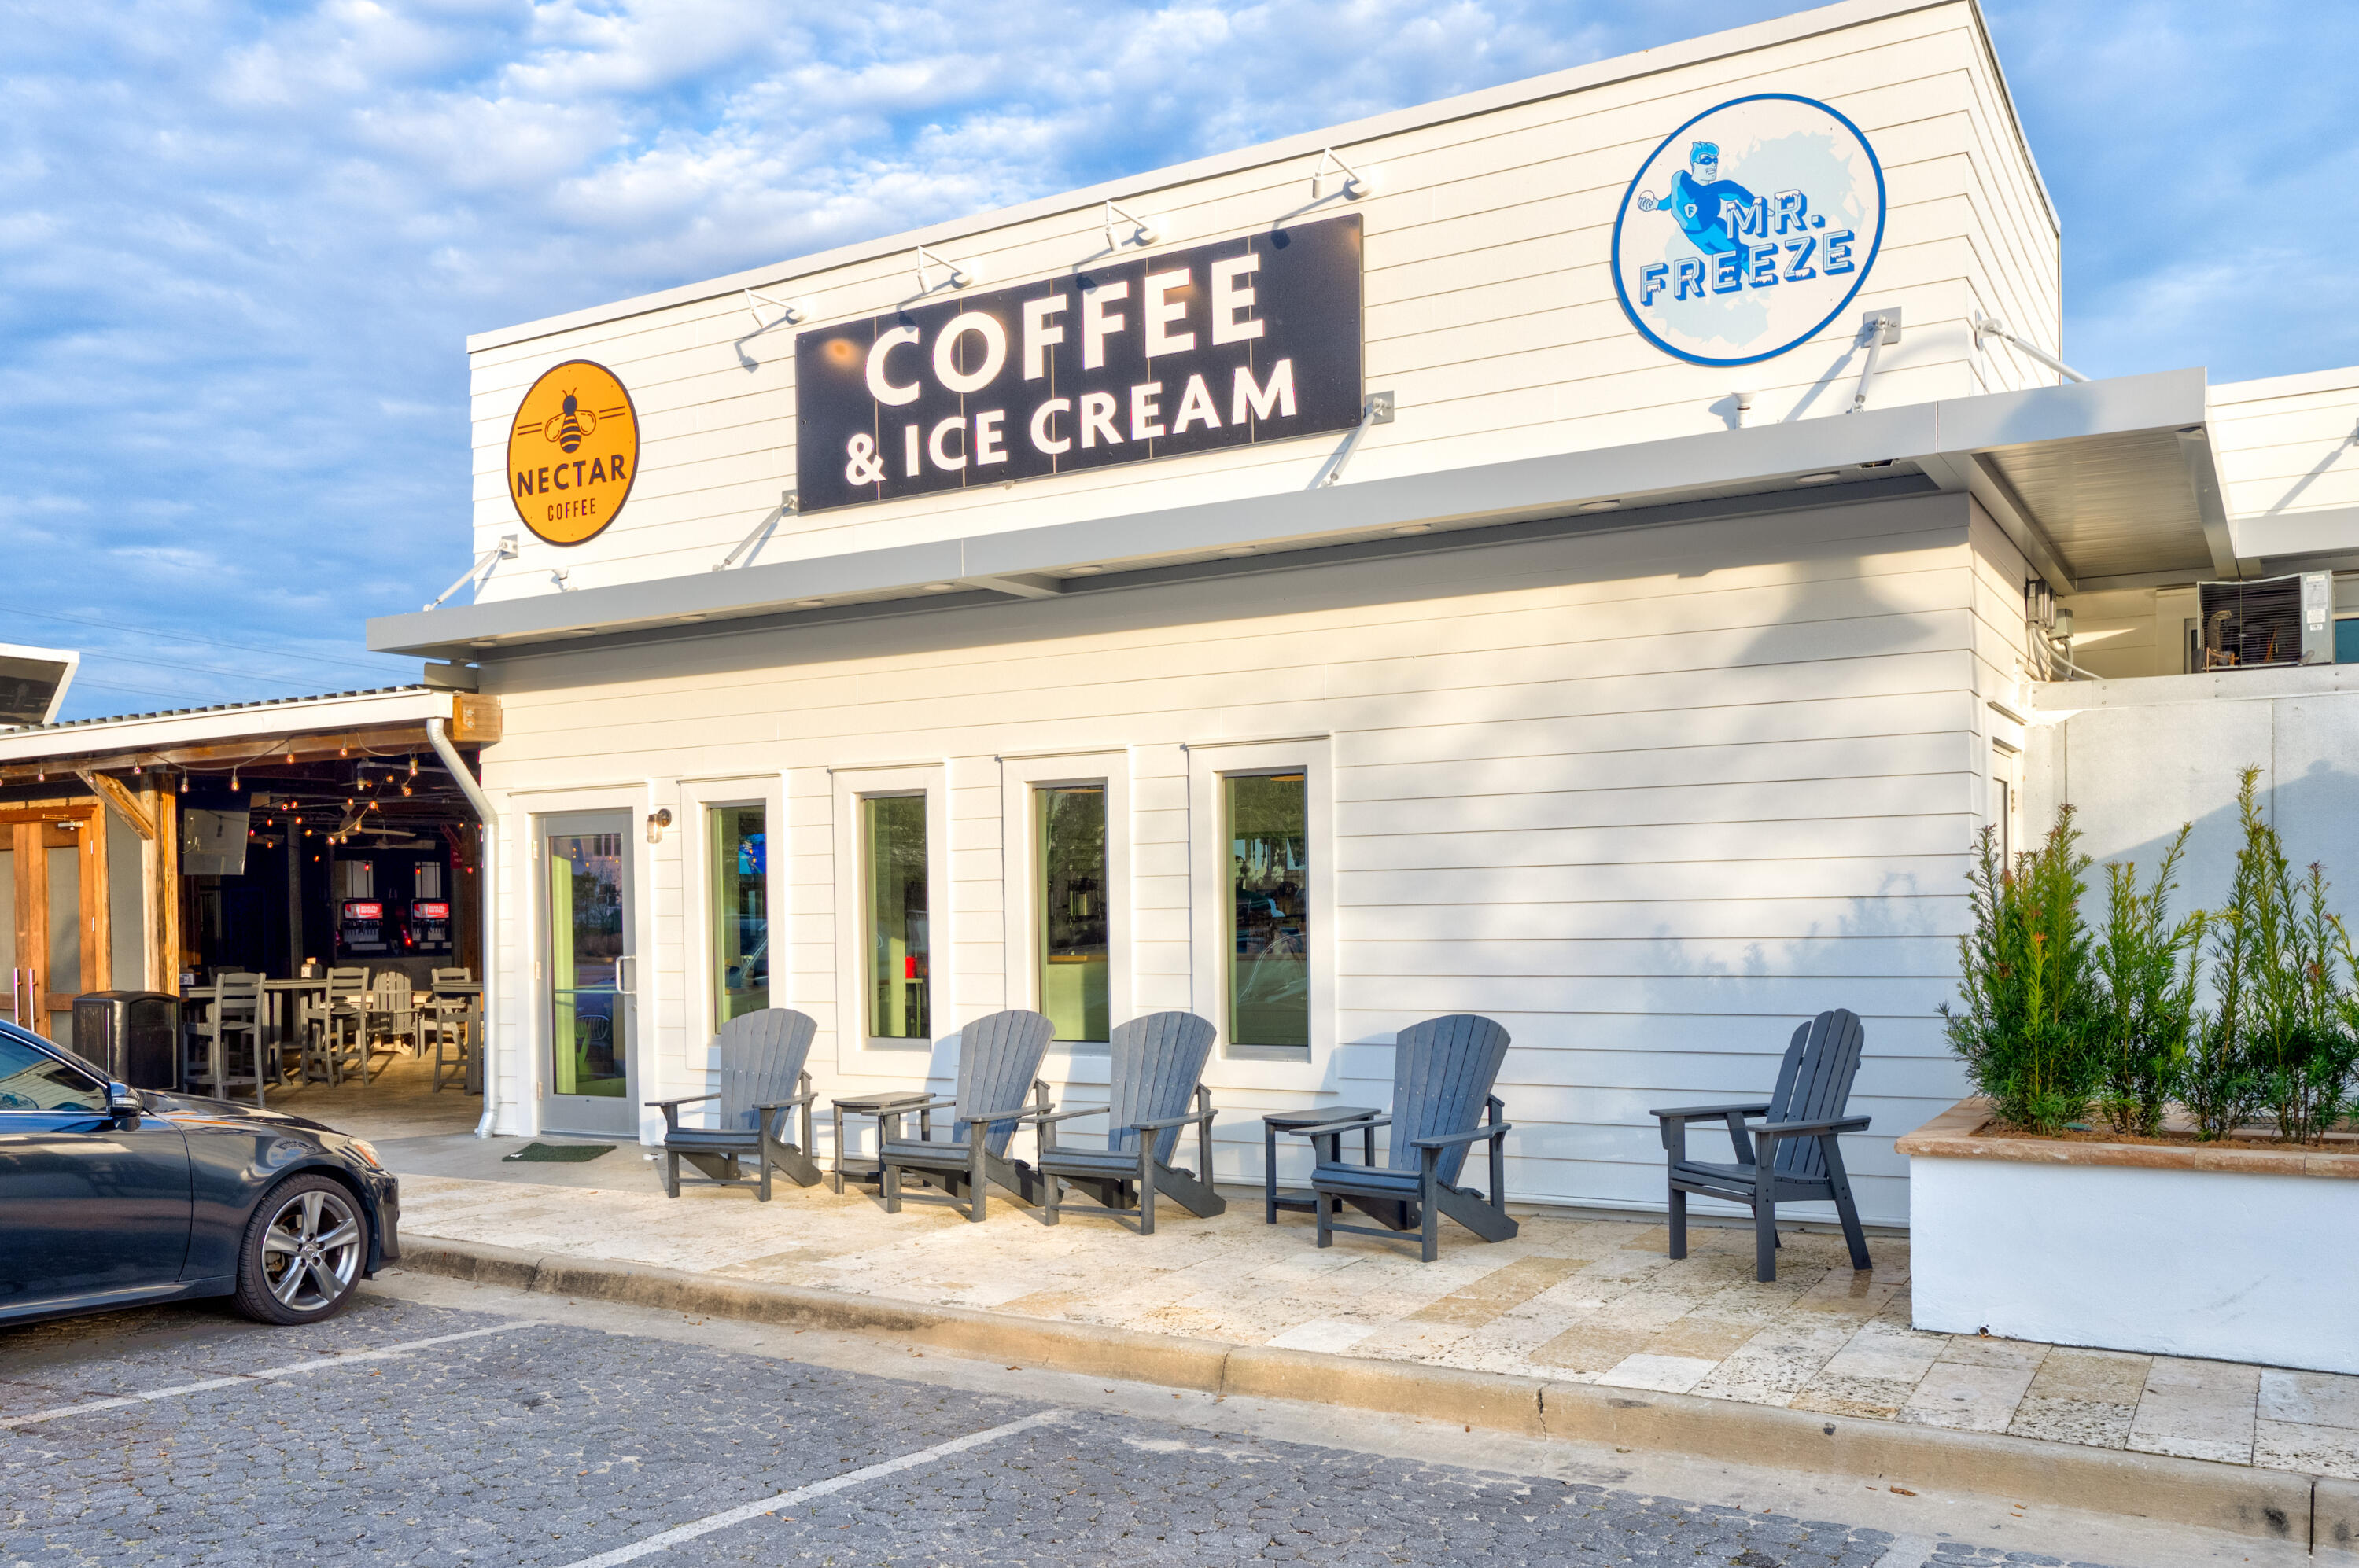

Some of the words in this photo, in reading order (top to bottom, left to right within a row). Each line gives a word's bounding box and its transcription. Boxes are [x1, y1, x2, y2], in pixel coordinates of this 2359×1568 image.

[1727, 190, 1825, 238] MR.
[1640, 230, 1855, 307] FREEZE
[865, 253, 1264, 407] COFFEE
[845, 433, 886, 486] &
[905, 409, 1008, 477] ICE
[1030, 359, 1297, 455] CREAM
[518, 454, 626, 497] NECTAR
[548, 498, 596, 521] COFFEE
